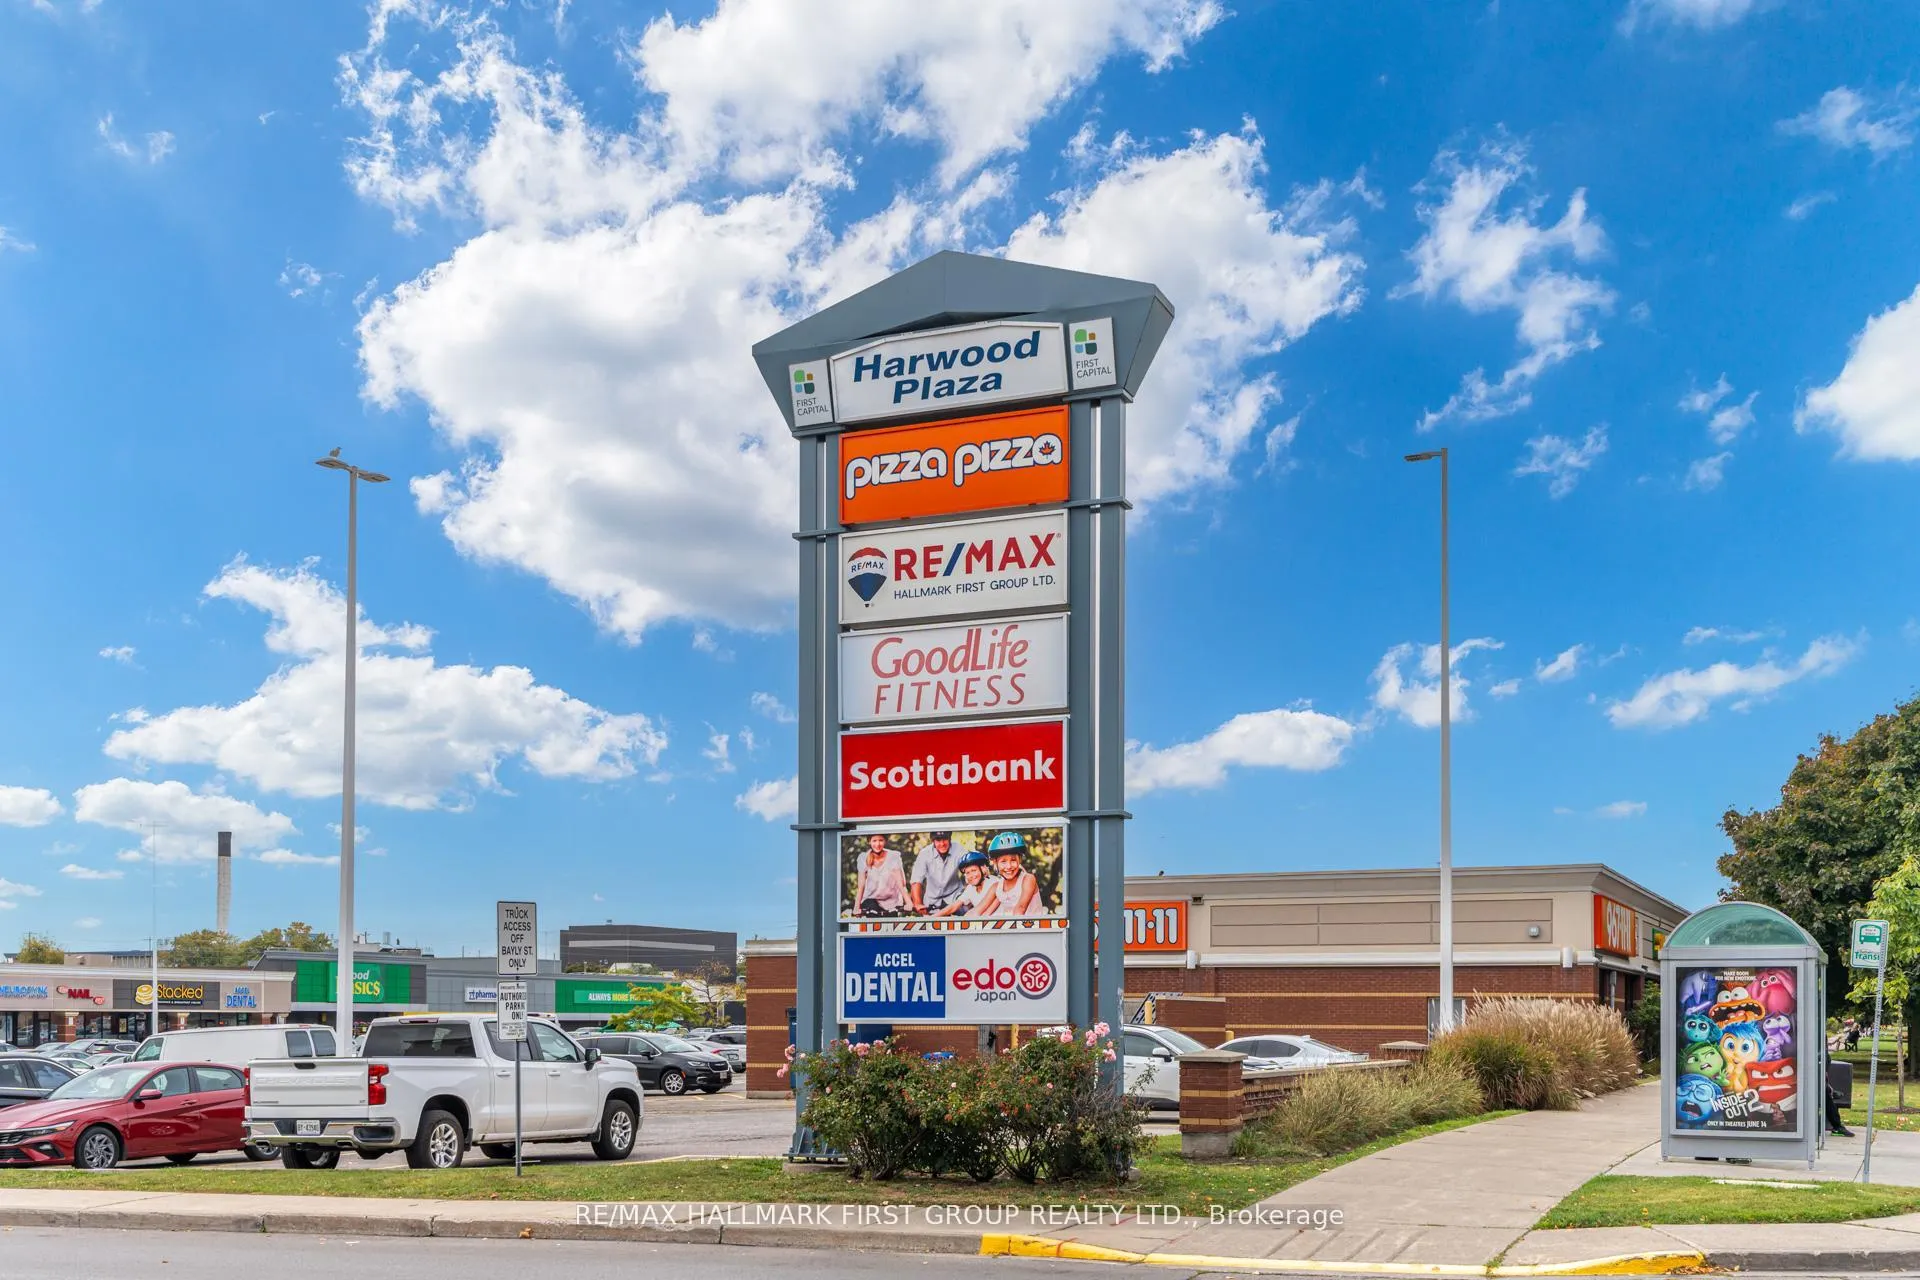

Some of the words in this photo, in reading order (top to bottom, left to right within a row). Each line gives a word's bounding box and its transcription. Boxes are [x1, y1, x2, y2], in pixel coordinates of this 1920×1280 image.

[853, 330, 1041, 382] Harwood
[1076, 358, 1098, 369] FIRST
[1076, 366, 1112, 378] CAPITAL
[893, 372, 1002, 403] Plaza
[796, 398, 816, 407] FIRST
[797, 405, 829, 416] CAPITAL
[845, 448, 947, 500] pizza
[953, 433, 1062, 487] pizza
[894, 533, 1055, 581] RE/MAX
[851, 561, 884, 573] RE/MAX
[894, 585, 951, 599] HALLMARK
[956, 582, 985, 594] FIRST
[990, 578, 1028, 590] GROUP
[1032, 575, 1056, 587] LTD.
[871, 624, 1029, 679] GoodLife
[874, 673, 1026, 714] FITNESS
[850, 749, 1056, 791] Scotiabank
[505, 909, 528, 919] TRUCK
[504, 921, 531, 931] ACCESS
[510, 934, 524, 943] OFF
[502, 946, 522, 955] BAYLY
[1855, 951, 1880, 961] Transi
[509, 958, 526, 968] ONLY
[874, 953, 915, 967] ACCEL
[352, 970, 370, 980] ood
[952, 959, 1015, 991] edo
[157, 984, 204, 999] Stacked
[845, 972, 944, 1003] DENTAL
[225, 995, 257, 1008] DENTAL
[974, 990, 1017, 1003] japan
[1710, 1092, 1747, 1112] INSIDE
[1725, 1102, 1748, 1119] OUT
[1744, 1088, 1764, 1112] 2
